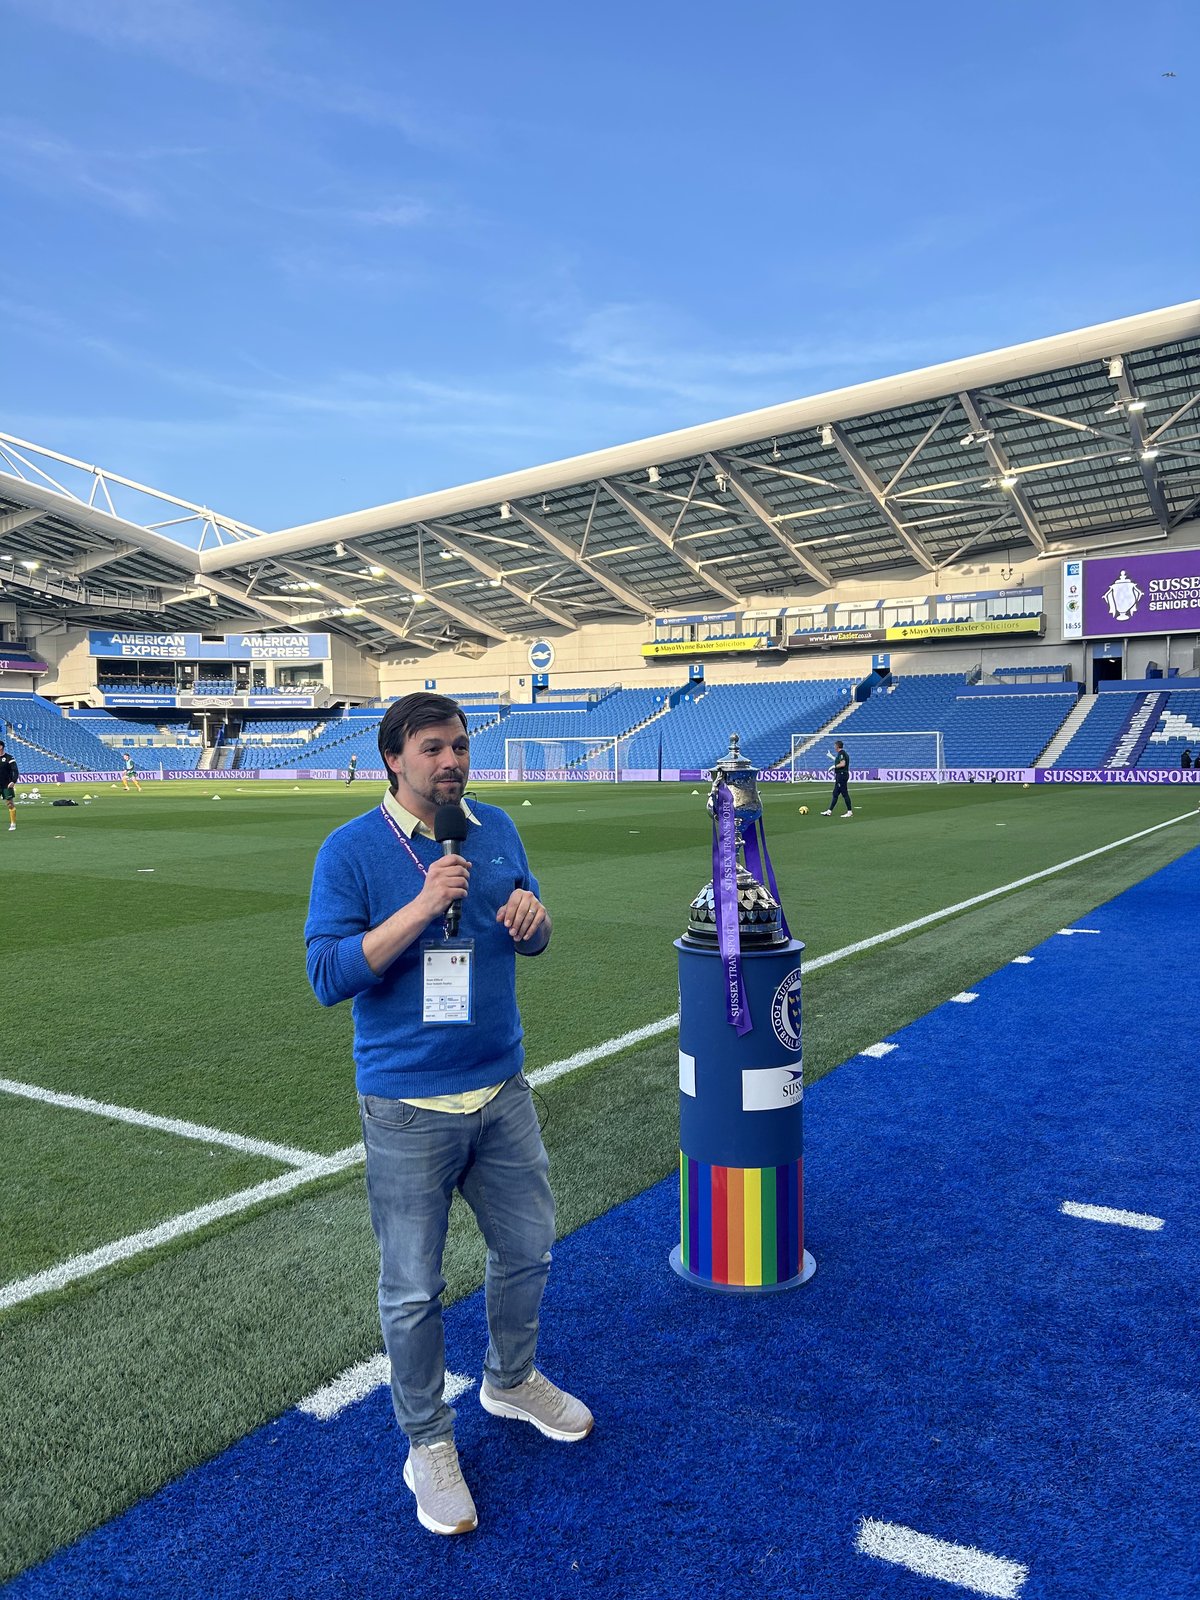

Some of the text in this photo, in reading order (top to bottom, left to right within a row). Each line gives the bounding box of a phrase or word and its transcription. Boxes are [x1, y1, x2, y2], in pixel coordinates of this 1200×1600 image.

[1149, 576, 1200, 592] SUSSE
[1149, 600, 1188, 611] SENIOR
[909, 619, 1020, 637] Mayo Wynne Baxter Solicitors
[111, 633, 185, 646] AMERICAN
[241, 636, 308, 647] AMERICAN
[122, 645, 187, 657] EXPRESS
[251, 647, 309, 657] EXPRESS
[660, 643, 675, 652] Mayo
[1104, 643, 1111, 652] F
[878, 654, 884, 663] E
[693, 665, 699, 674] D
[537, 674, 543, 682] C
[70, 773, 104, 782] SUSSEX
[168, 771, 254, 780] SUSSEX TRANSPORT
[340, 770, 371, 779] SUSEX
[522, 771, 616, 780] SUSSEX TRANSPORT
[756, 770, 792, 782] USSEX
[886, 771, 1025, 782] SUSSEX TRANSPORT
[1043, 770, 1102, 783] SUSSEX
[722, 799, 733, 891] SUSSEX TRANSPORT
[727, 923, 739, 1017] SUSSEX TRANSPORT
[777, 972, 798, 1001] SUSSEX
[774, 1005, 795, 1048] FOOTBALL
